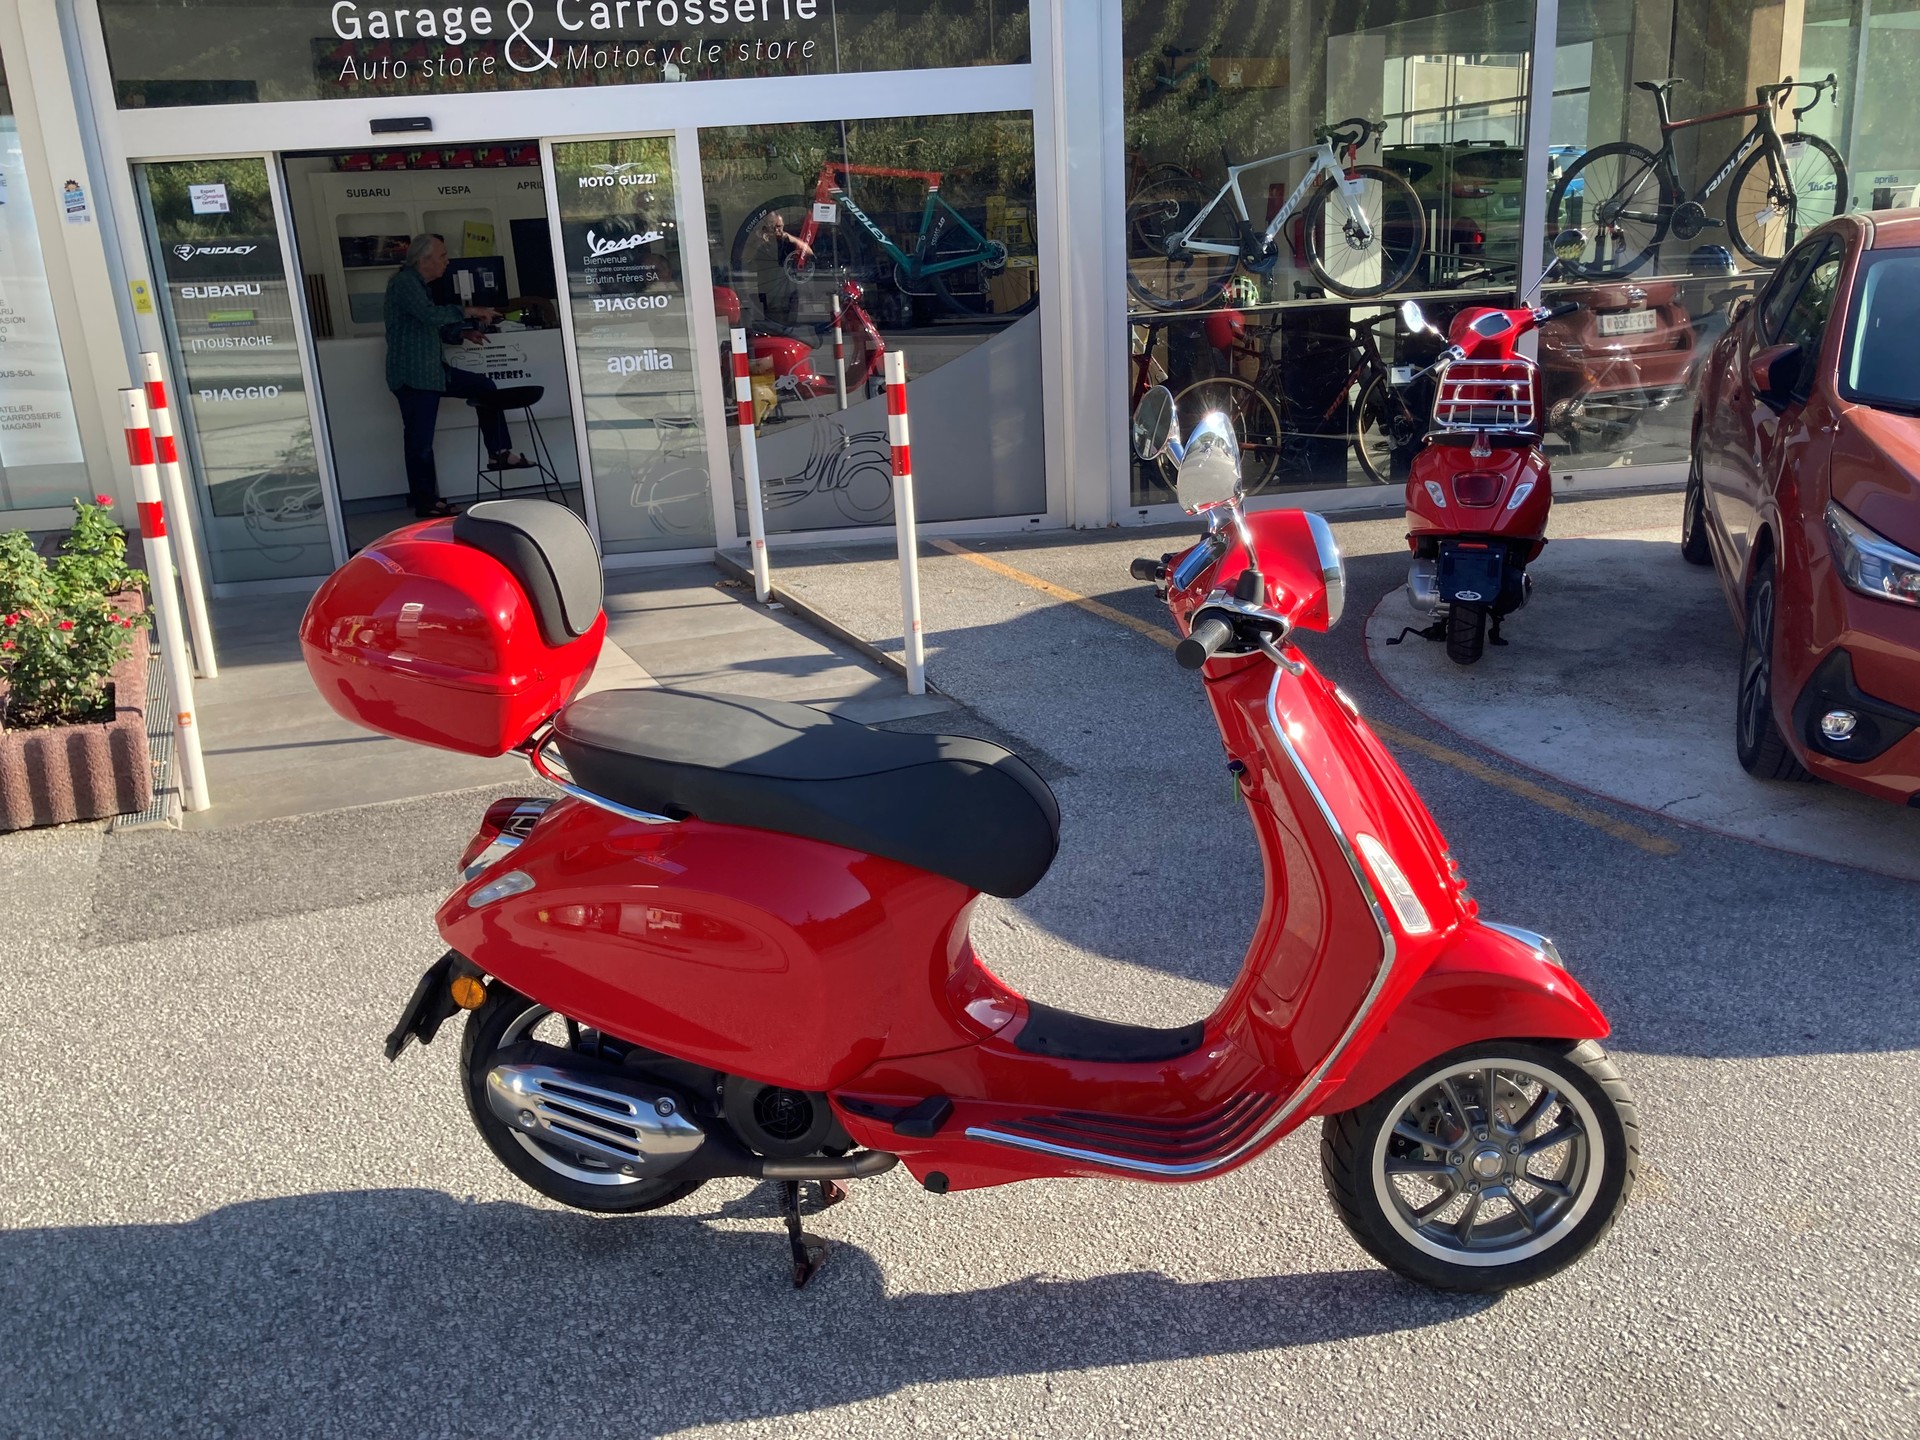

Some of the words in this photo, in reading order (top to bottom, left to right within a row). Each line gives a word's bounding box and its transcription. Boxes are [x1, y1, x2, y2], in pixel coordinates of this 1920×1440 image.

[331, 0, 493, 46] Garage
[504, 0, 559, 73] &
[556, 0, 818, 31] Carrosserie
[567, 39, 721, 72] Motocycle
[738, 38, 816, 62] store
[339, 55, 407, 81] Auto
[422, 53, 496, 78] store
[1705, 133, 1756, 199] RIDLEY
[578, 176, 615, 188] MOTO
[618, 173, 657, 186] GUZZI
[742, 172, 778, 182] PIAGGIO
[1874, 174, 1899, 185] aprilia
[346, 188, 391, 198] SUBARU
[437, 185, 471, 195] VESPA
[1273, 160, 1321, 232] RIDLEY
[840, 196, 893, 246] RIDLEY
[195, 245, 257, 255] RIDLEY
[587, 230, 664, 258] Vespa
[583, 256, 627, 266] Bienvenue
[613, 264, 656, 272] concessionnaire
[585, 275, 614, 285] Bruttin
[616, 273, 644, 283] Frères
[646, 272, 660, 282] SA
[181, 283, 261, 299] SUBARU
[593, 295, 669, 312] PIAGGIO
[607, 349, 673, 376] aprilia
[199, 385, 279, 403] PIAGGIO
[0, 411, 62, 422] CARROSSERIE
[2, 422, 41, 431] MAGASIN
